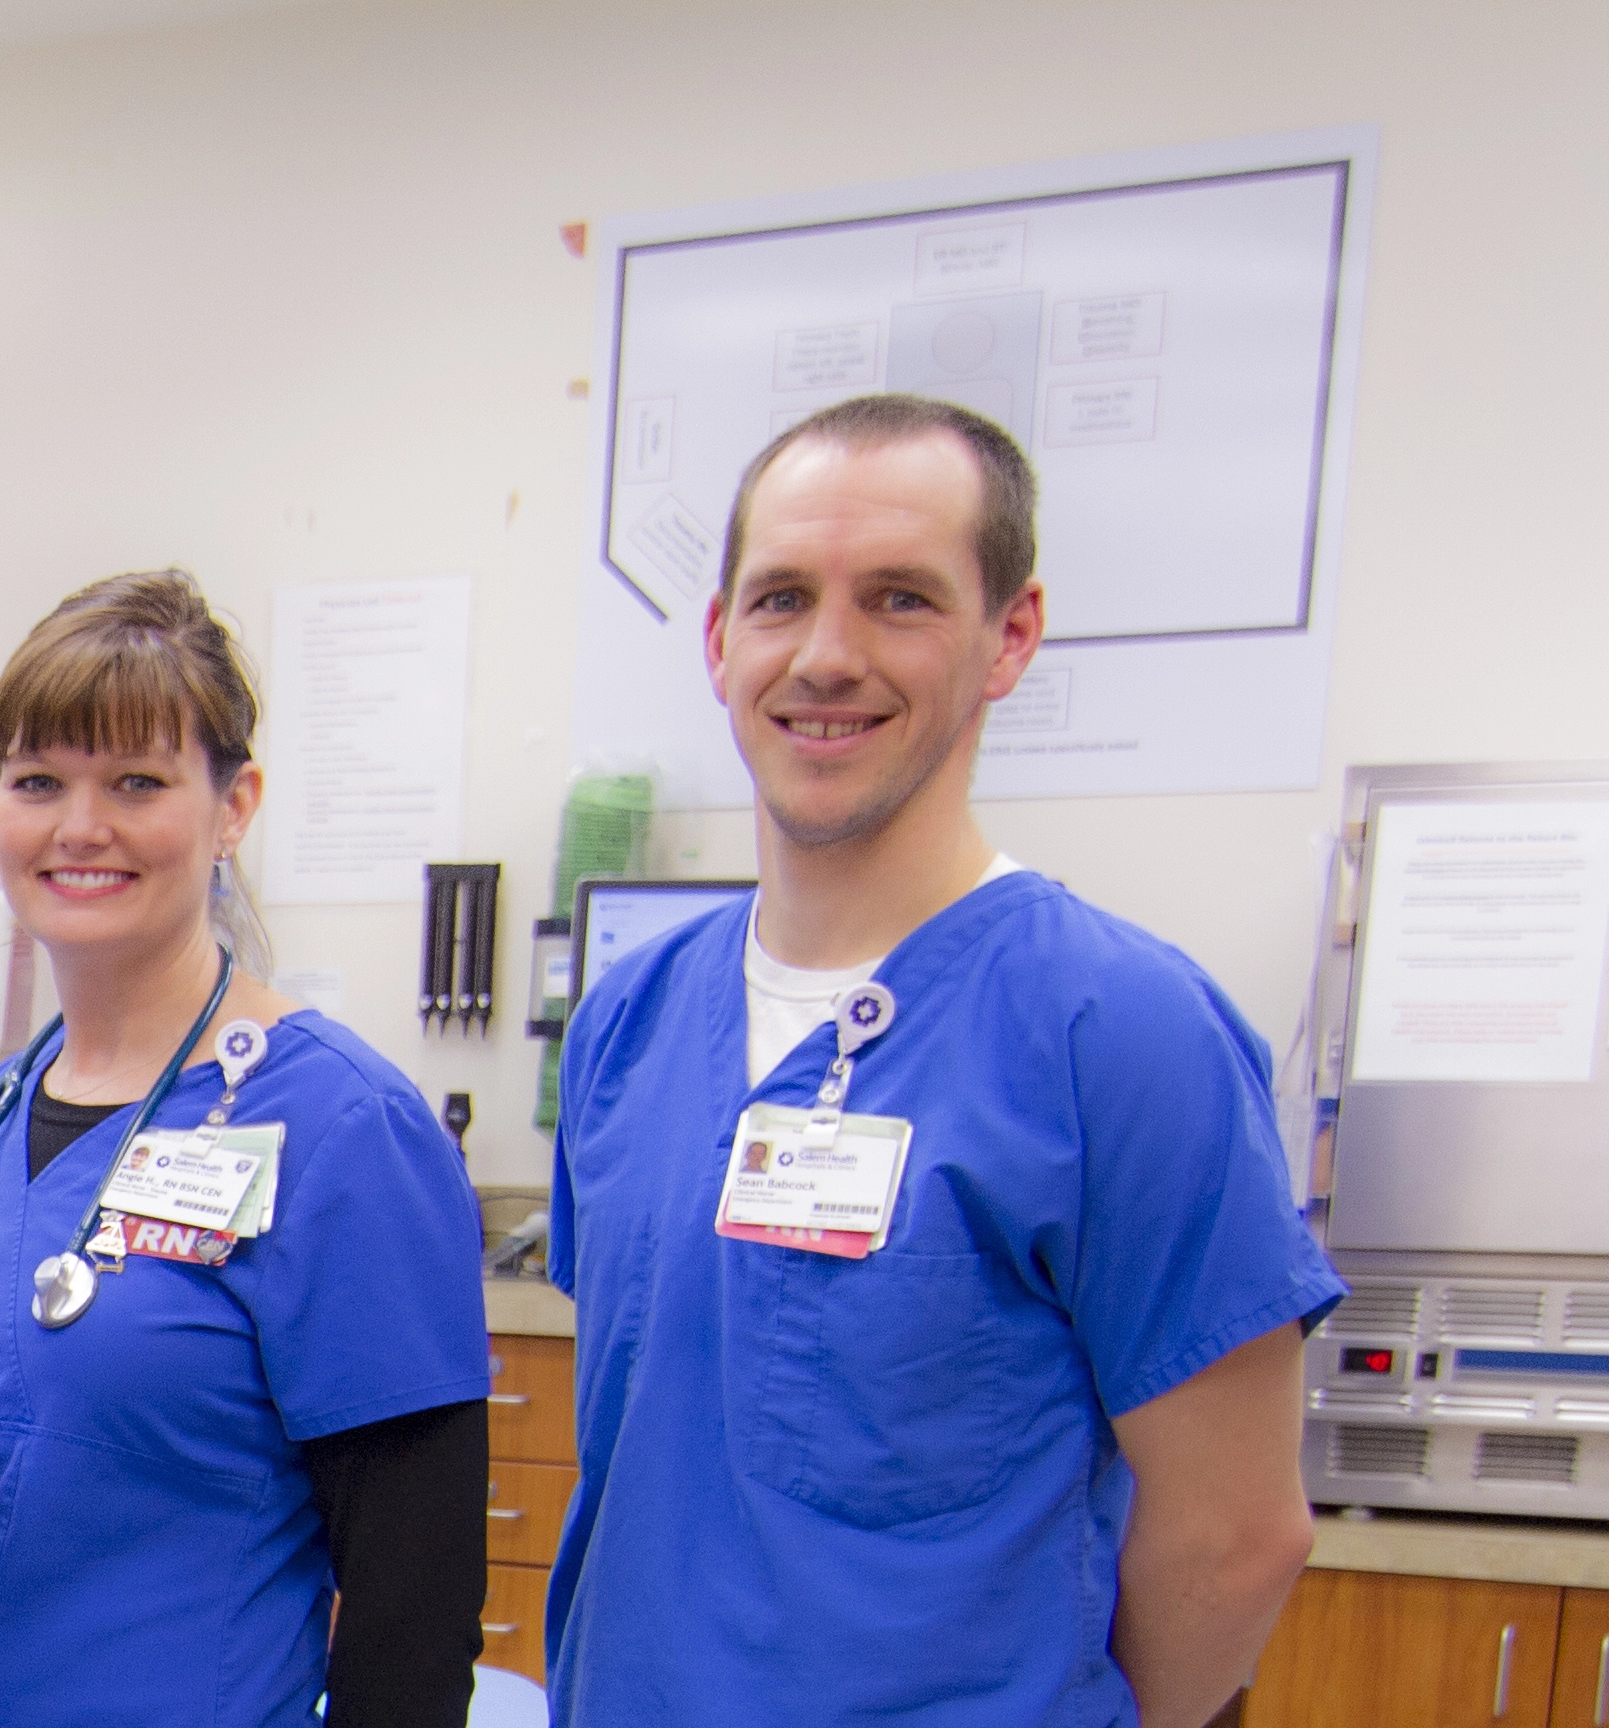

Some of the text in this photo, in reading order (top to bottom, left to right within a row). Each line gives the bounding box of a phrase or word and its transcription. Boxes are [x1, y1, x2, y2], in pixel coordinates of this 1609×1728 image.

[736, 1177, 816, 1191] Sean Babcock
[133, 1223, 197, 1256] RN
